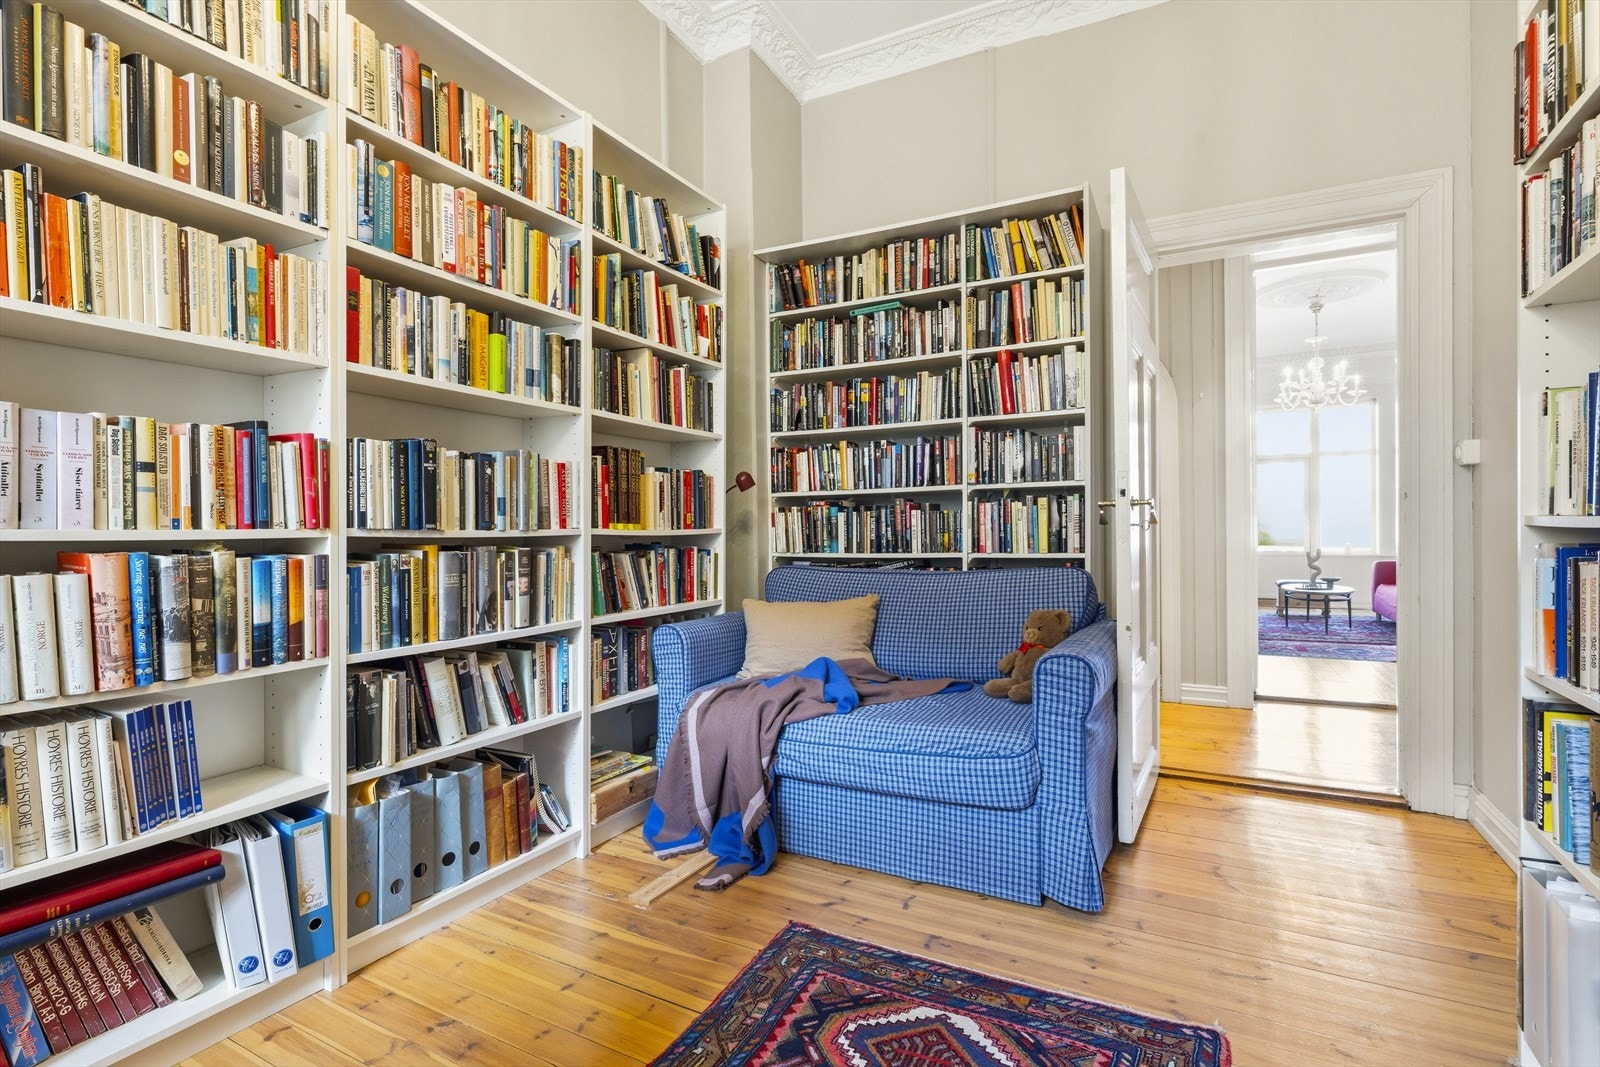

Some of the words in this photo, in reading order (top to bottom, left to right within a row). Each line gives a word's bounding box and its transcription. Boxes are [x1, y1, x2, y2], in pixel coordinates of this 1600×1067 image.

[21, 17, 29, 75] HANNE-VIBEKE
[22, 76, 30, 100] HOLST
[364, 84, 376, 114] MANN
[13, 177, 24, 196] KNUT
[383, 179, 391, 195] JON
[402, 172, 410, 194] JON
[560, 167, 568, 200] 1968
[14, 197, 25, 240] FALDBAKKEN
[403, 195, 411, 240] MICHELET
[93, 220, 101, 264] BJØRNEBOE
[479, 345, 487, 382] MAGNET
[110, 428, 120, 437] Dag
[112, 438, 120, 456] Solstad
[158, 426, 168, 441] DAG
[217, 429, 225, 446] ESPEN
[158, 442, 168, 475] SOLSTAD
[0, 460, 11, 497] Åttitallet
[34, 463, 44, 502] Syttitallet
[75, 467, 83, 487] Siste
[75, 488, 83, 510] tiåret
[124, 483, 132, 507] Solstad
[124, 508, 133, 520] Dag
[134, 558, 145, 584] Storting
[134, 585, 142, 594] og
[224, 587, 233, 617] Vigeland
[136, 596, 146, 624] regjering
[380, 585, 389, 625] Wildenvey
[36, 621, 47, 650] NORGE
[74, 619, 84, 648] NORGE
[538, 655, 546, 677] ERIK
[11, 735, 29, 780] HØYRES
[46, 729, 63, 772] HØYRES
[77, 725, 93, 769] HØYRES
[15, 781, 33, 830] HISTORIE
[50, 775, 67, 822] HISTORIE
[82, 770, 97, 816] HISTORIE
[39, 1006, 56, 1023] A-B
[54, 998, 72, 1016] C-G
